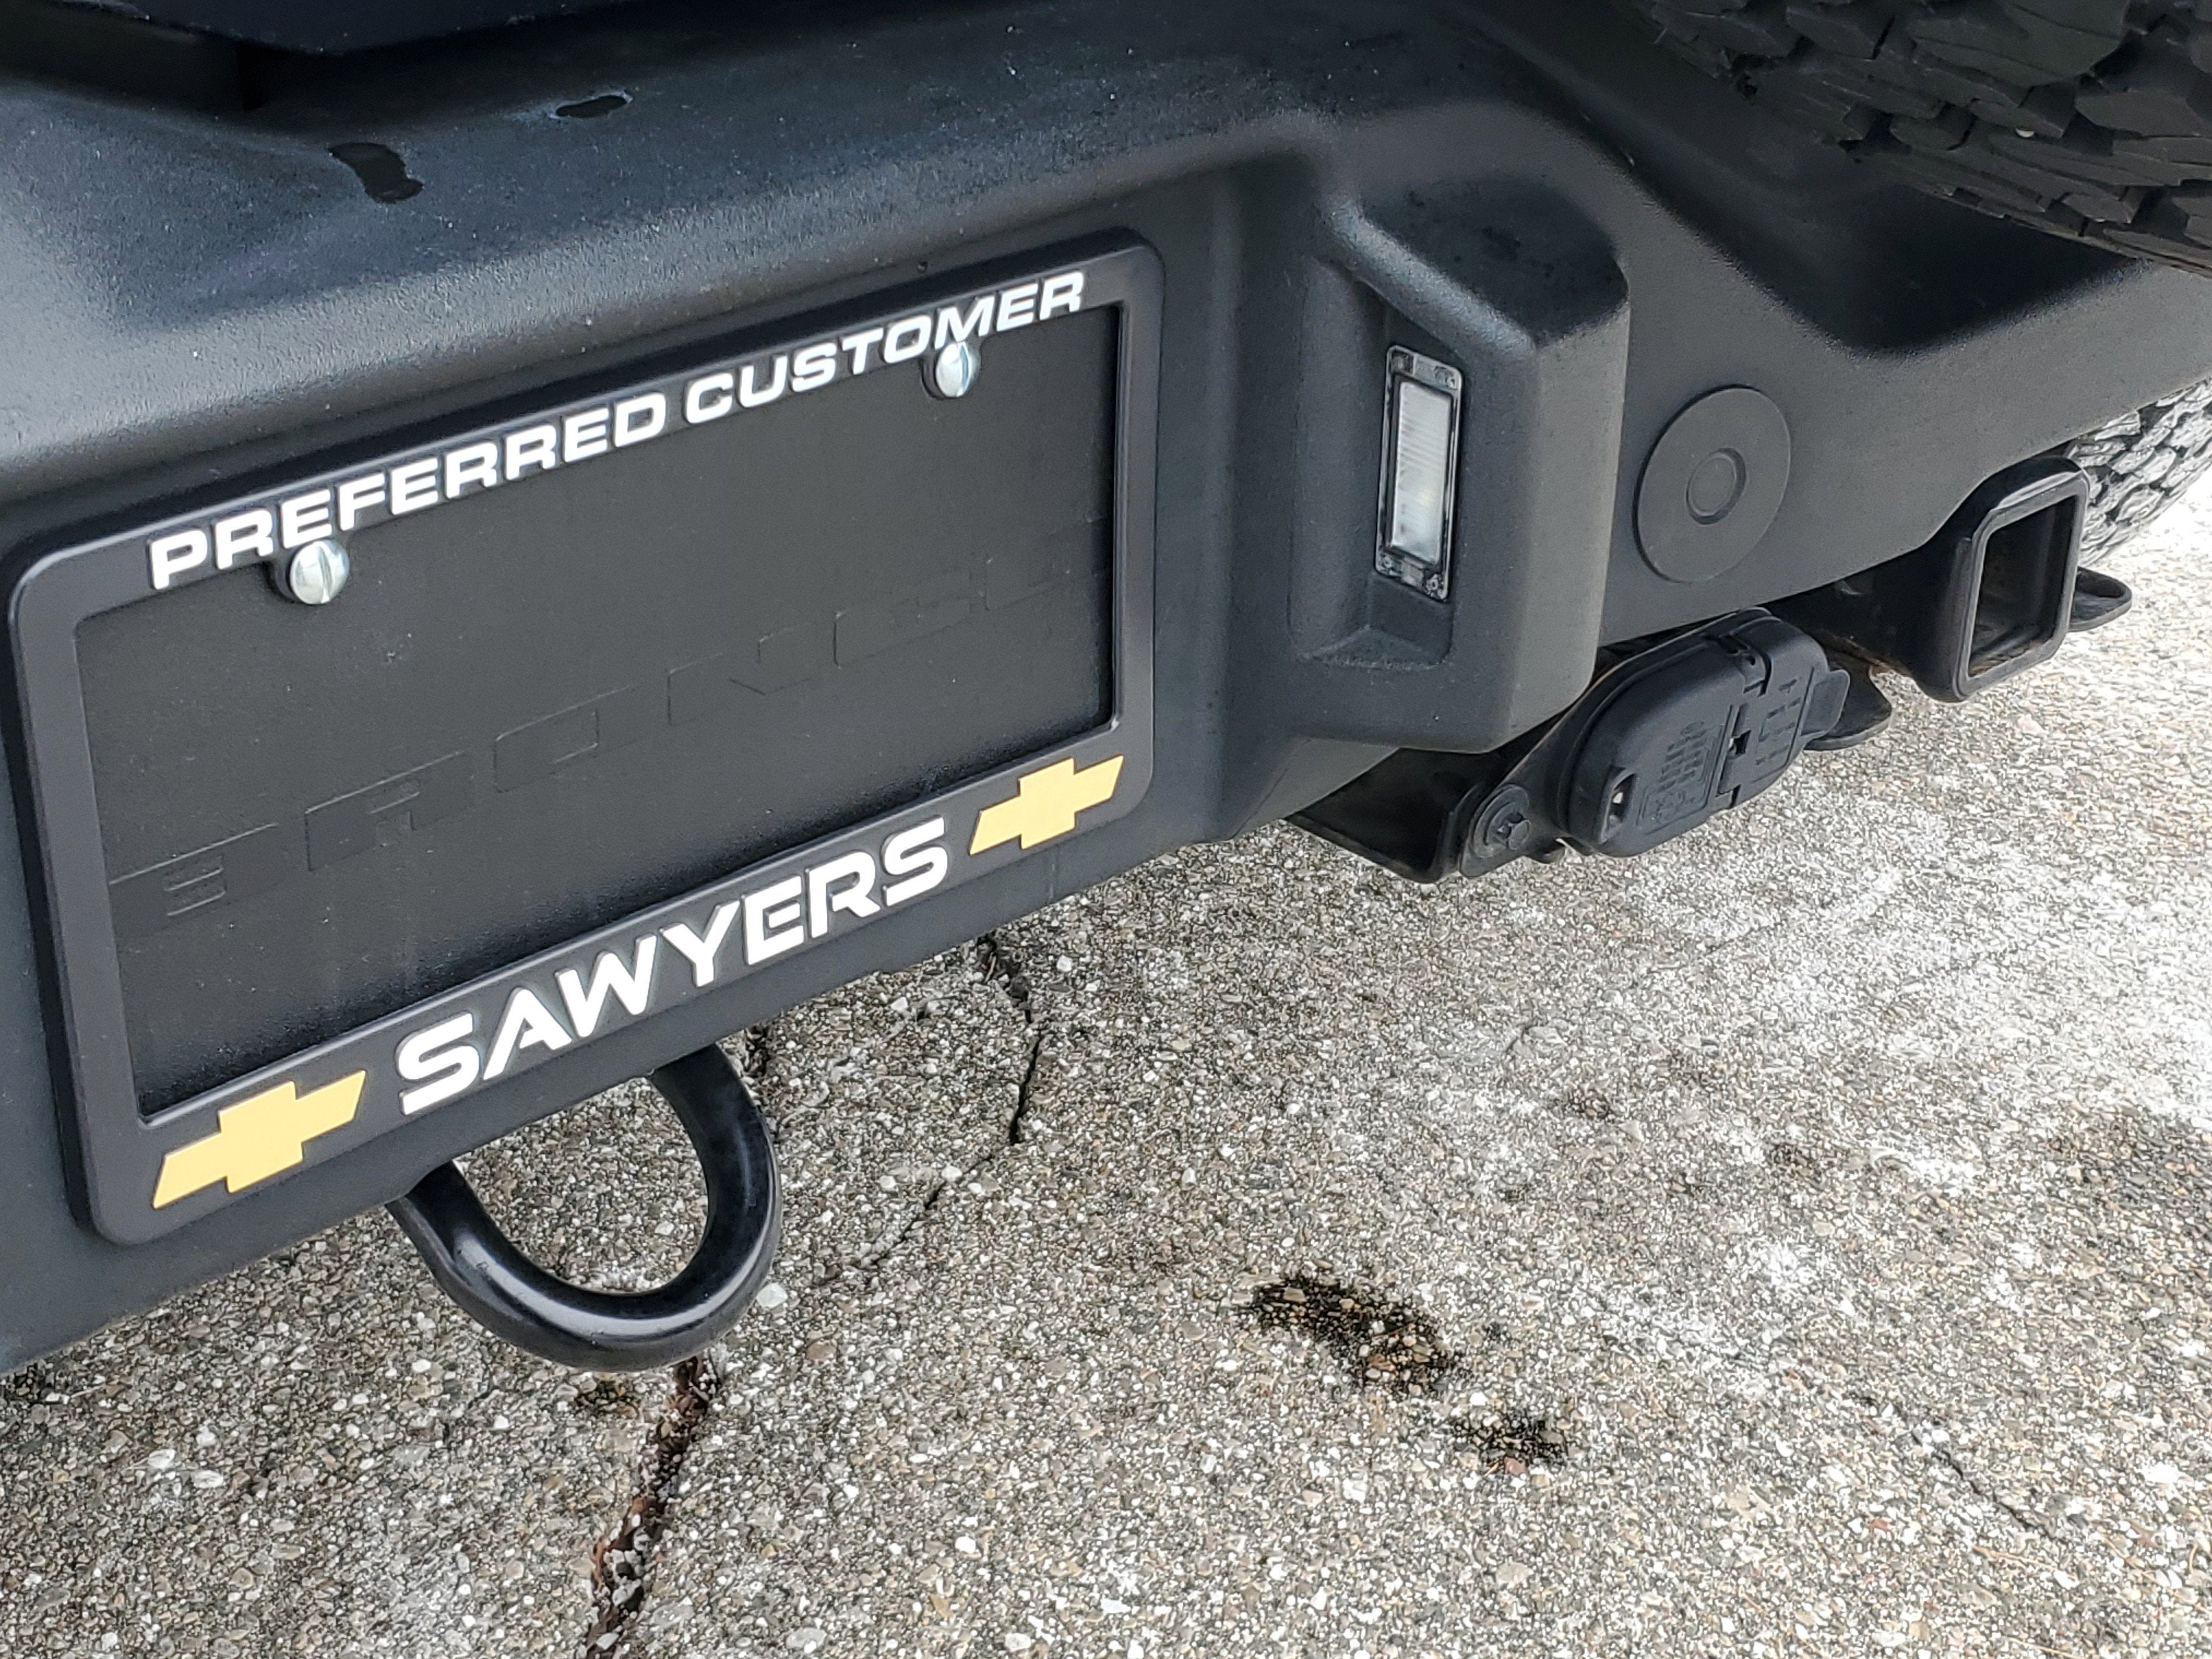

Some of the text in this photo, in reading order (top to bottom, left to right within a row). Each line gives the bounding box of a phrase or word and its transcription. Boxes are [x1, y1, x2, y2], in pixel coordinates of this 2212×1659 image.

[149, 270, 1086, 590] PREFERRED CUSTOMER
[396, 816, 949, 1116] SAWYERS
